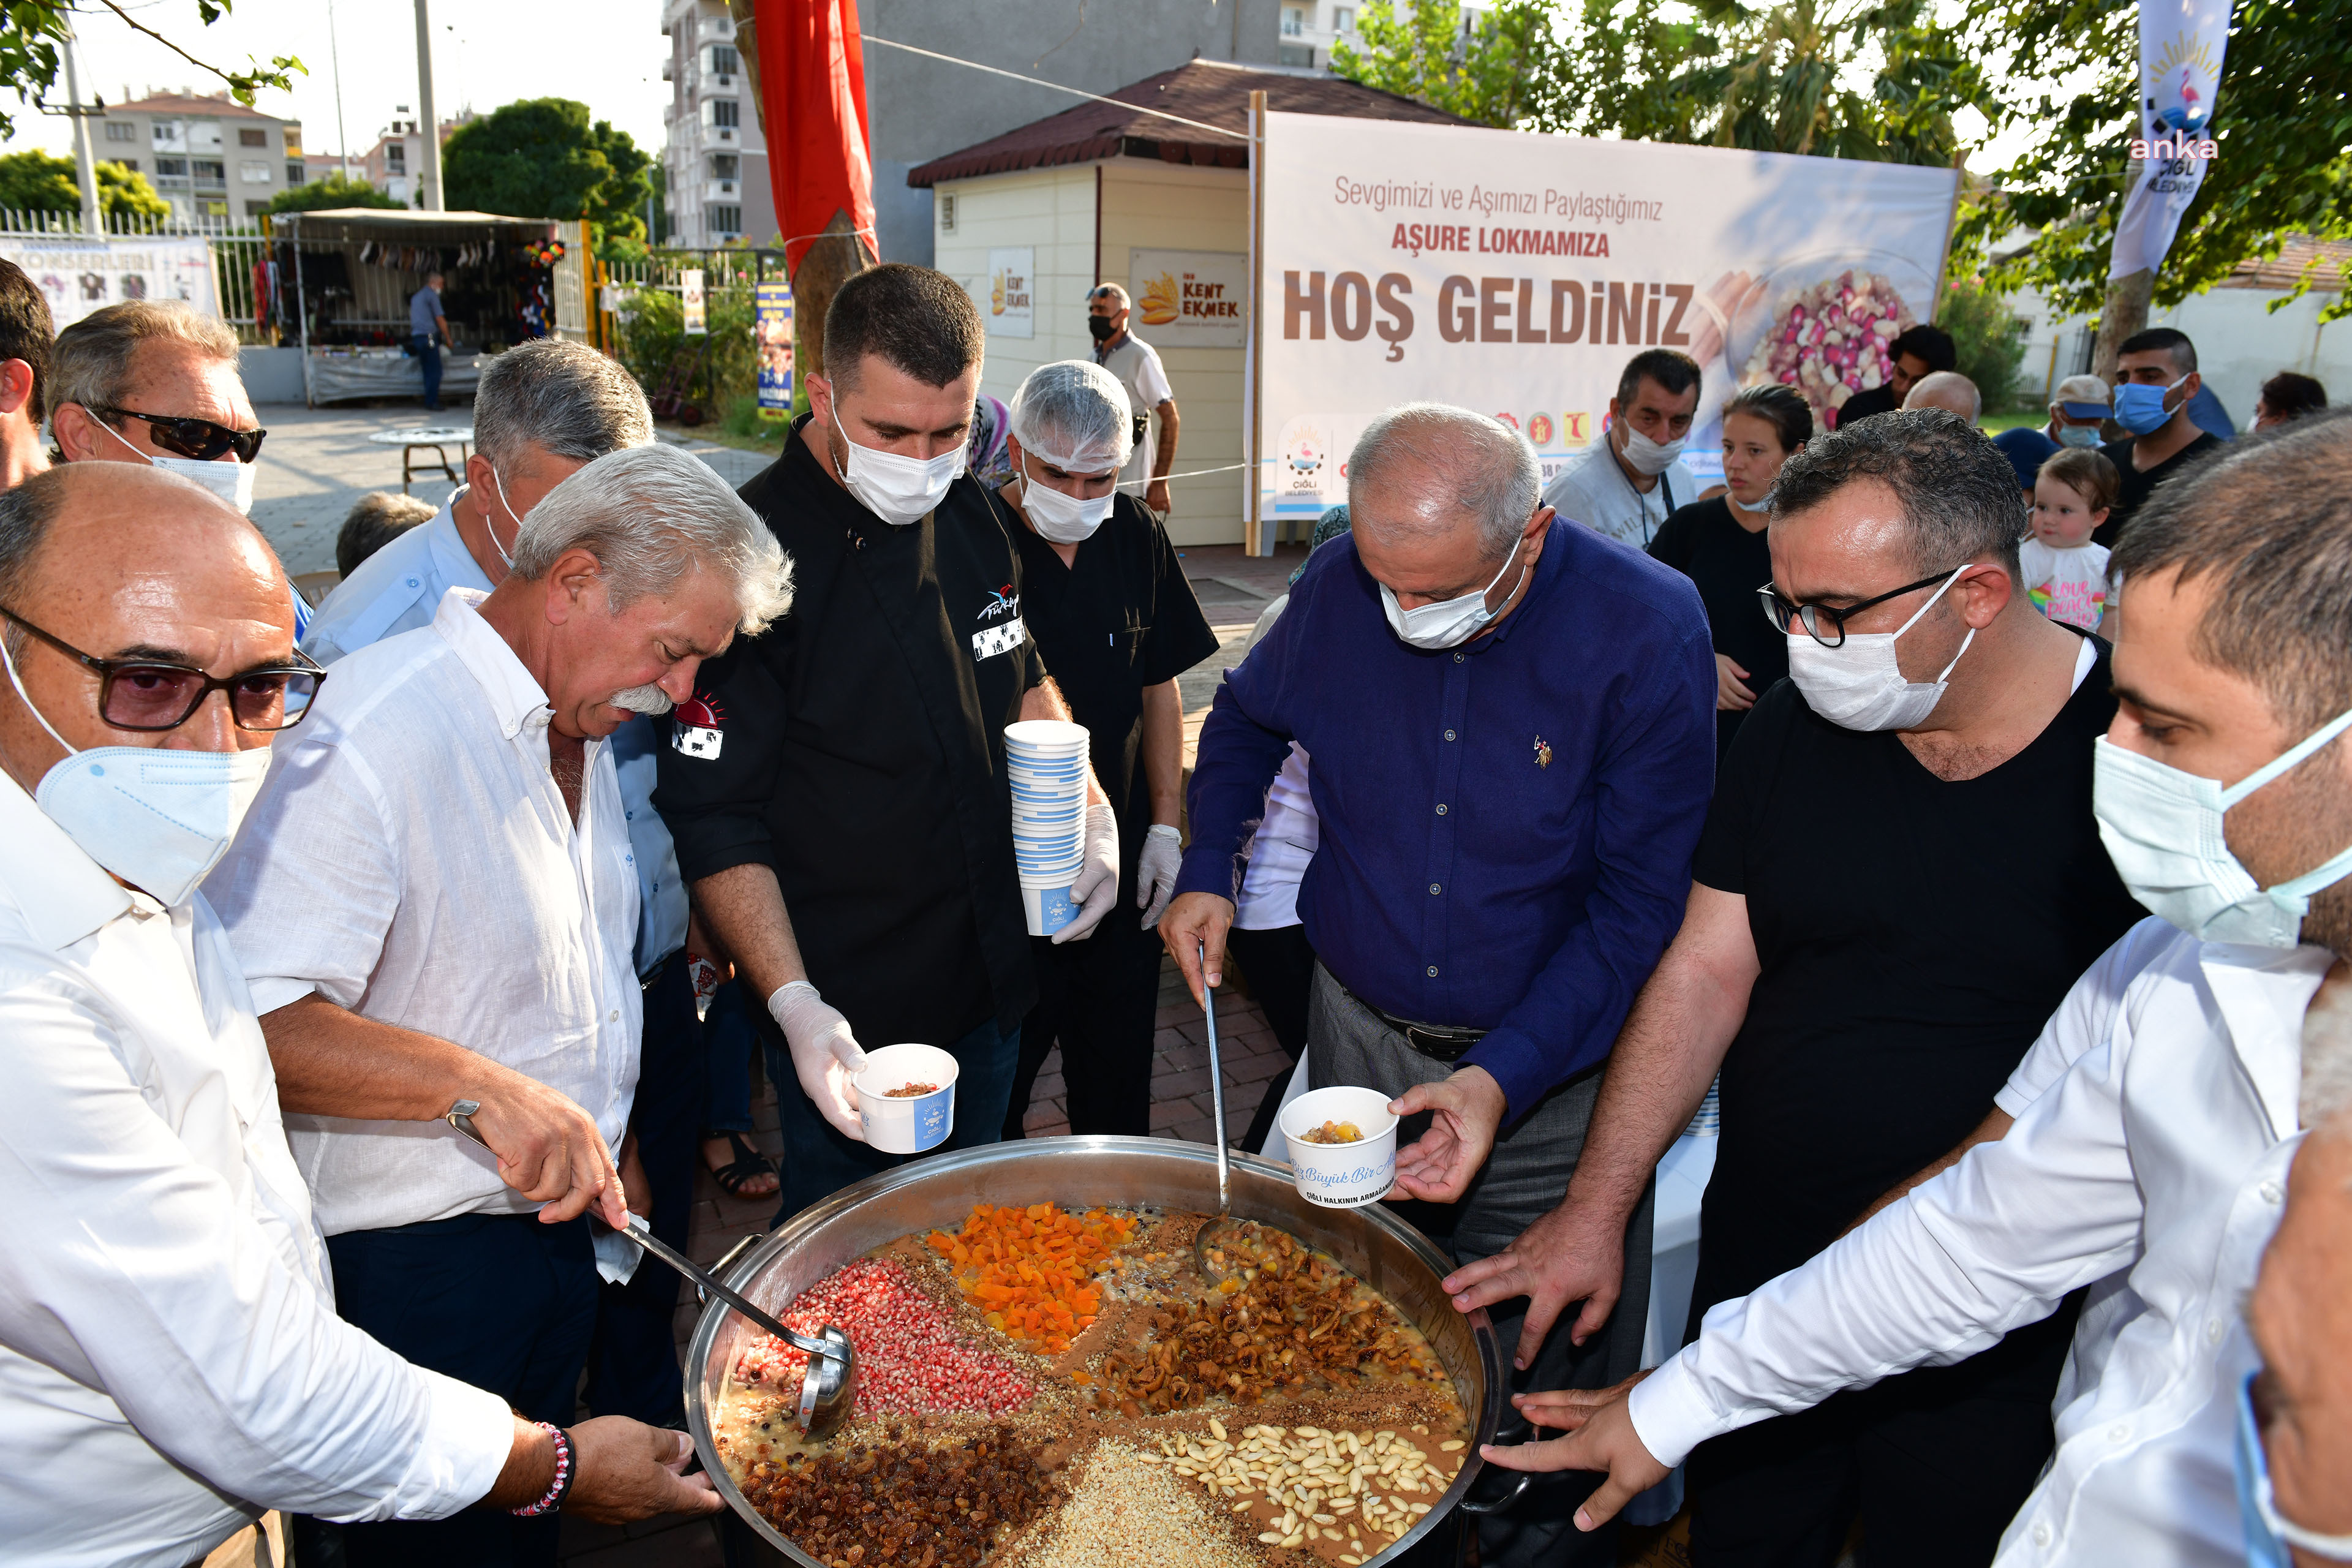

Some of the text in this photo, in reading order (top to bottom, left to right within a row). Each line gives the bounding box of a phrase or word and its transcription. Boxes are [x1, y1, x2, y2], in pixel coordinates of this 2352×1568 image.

[1335, 176, 1663, 225] Sevgimizi ve Aşımızı Paylaştığımız
[1392, 223, 1610, 258] AŞURE LOKMAMIZA
[1183, 282, 1225, 300] KENT
[1183, 301, 1238, 318] EKMEK
[1284, 270, 1414, 363] HOŞ
[1291, 1158, 1305, 1182] Biz
[1305, 1167, 1350, 1188] Büyük
[1351, 1166, 1375, 1183] Bir
[1306, 1191, 1322, 1202] ÇİĞLİ
[1324, 1196, 1359, 1205] HALKININ
